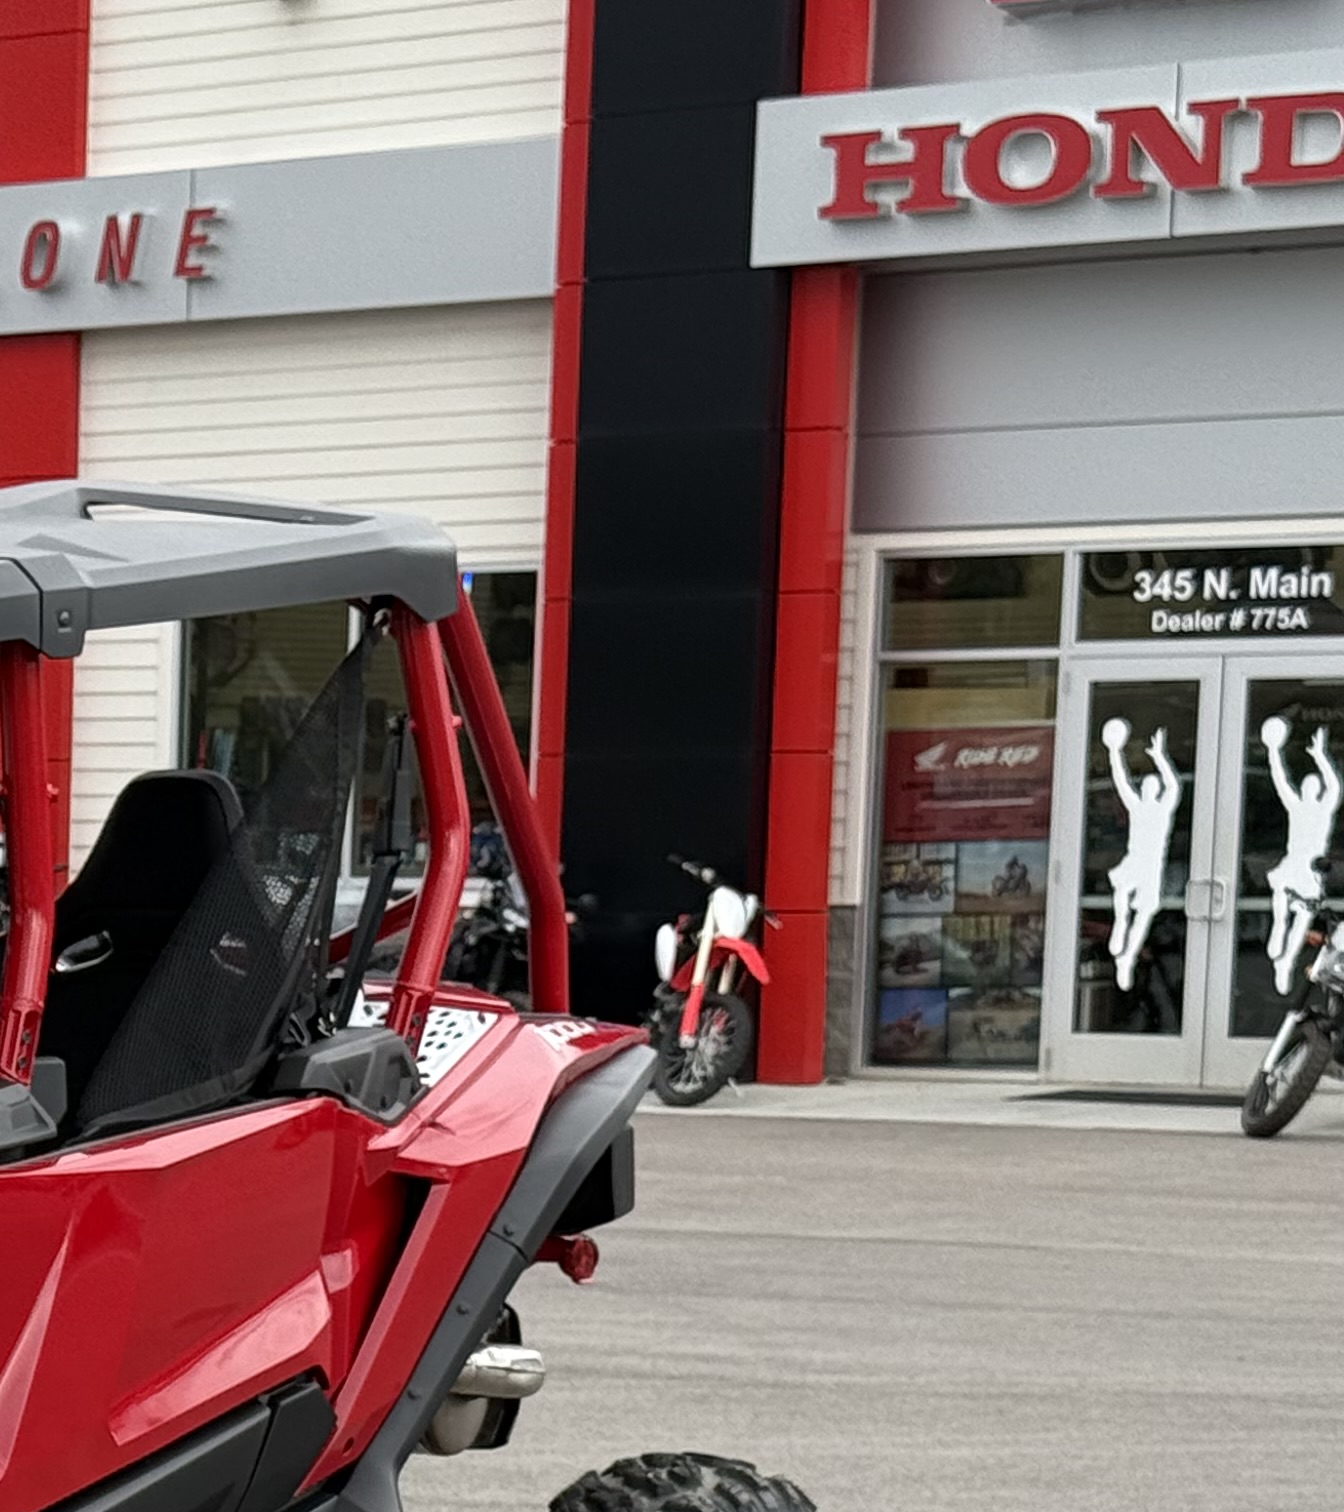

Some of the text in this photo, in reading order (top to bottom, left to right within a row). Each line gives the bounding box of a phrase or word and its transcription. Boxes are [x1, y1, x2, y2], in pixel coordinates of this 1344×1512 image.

[818, 91, 1344, 221] HOND
[1133, 564, 1333, 602] 345 N. Main
[1150, 606, 1310, 633] Dealer # 775A
